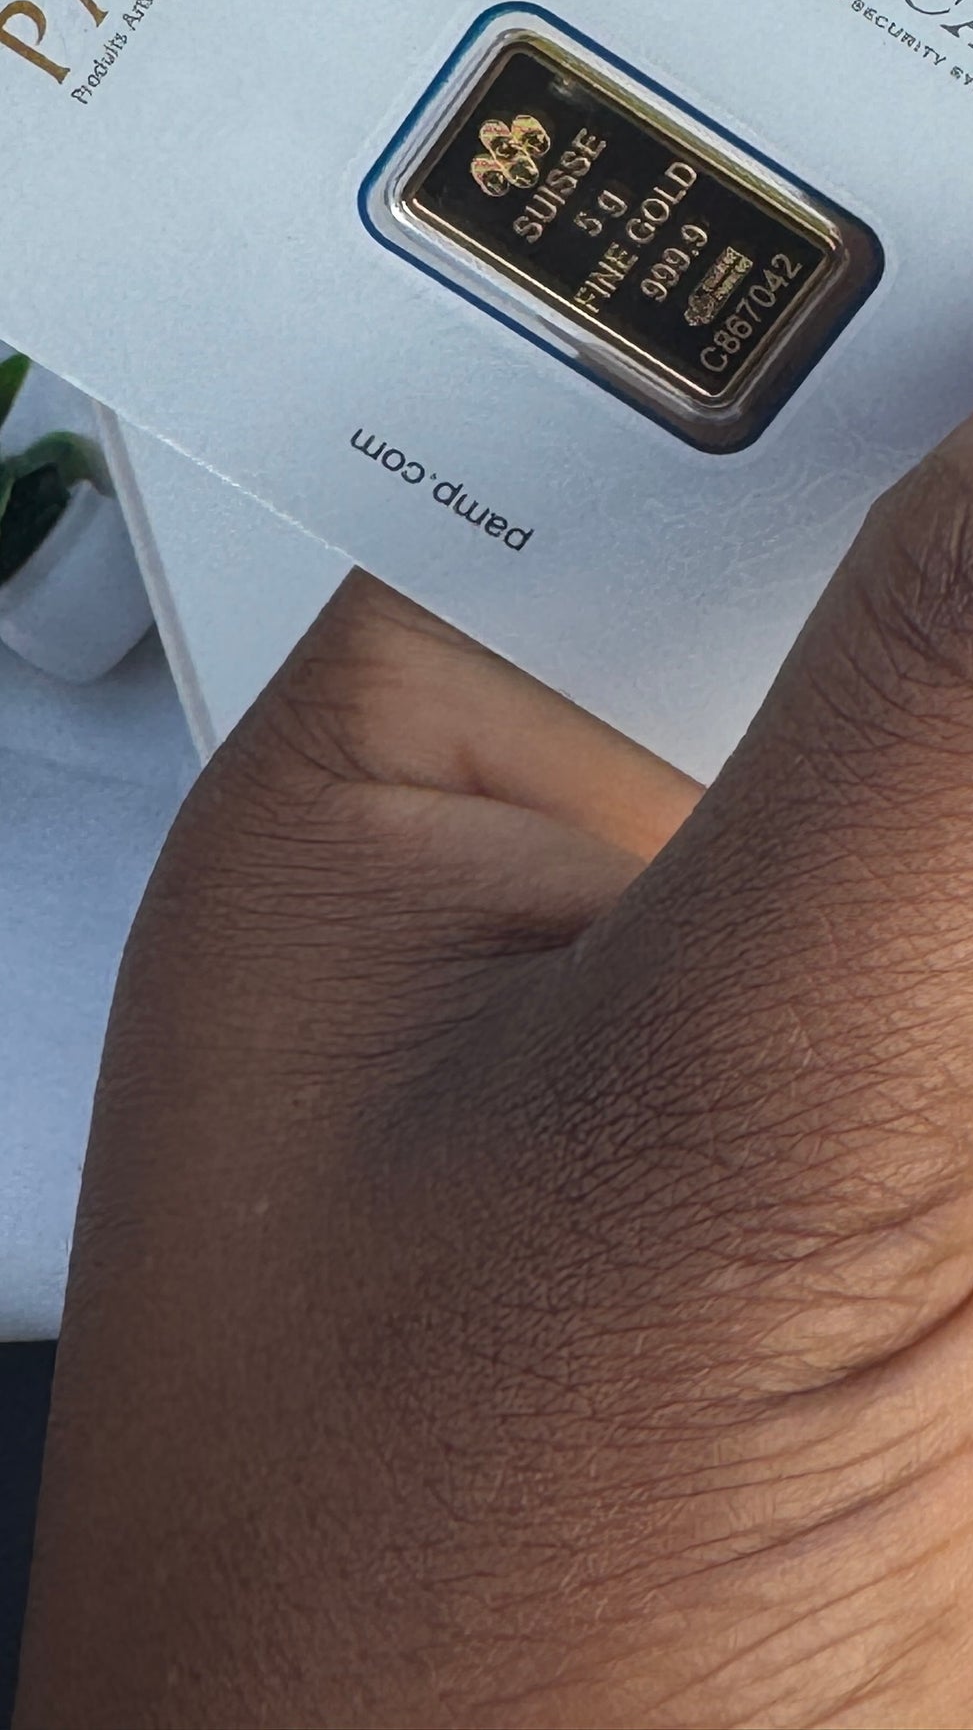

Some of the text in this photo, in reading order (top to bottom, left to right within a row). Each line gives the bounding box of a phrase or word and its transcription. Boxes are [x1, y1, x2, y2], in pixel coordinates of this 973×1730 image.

[71, 31, 128, 104] Produits
[513, 128, 607, 244] SUISSE
[574, 190, 628, 237] 5 g
[574, 162, 697, 313] FINE GOLD
[641, 224, 708, 302] 999.9
[700, 253, 804, 372] C867042
[350, 428, 535, 551] pamp.com
